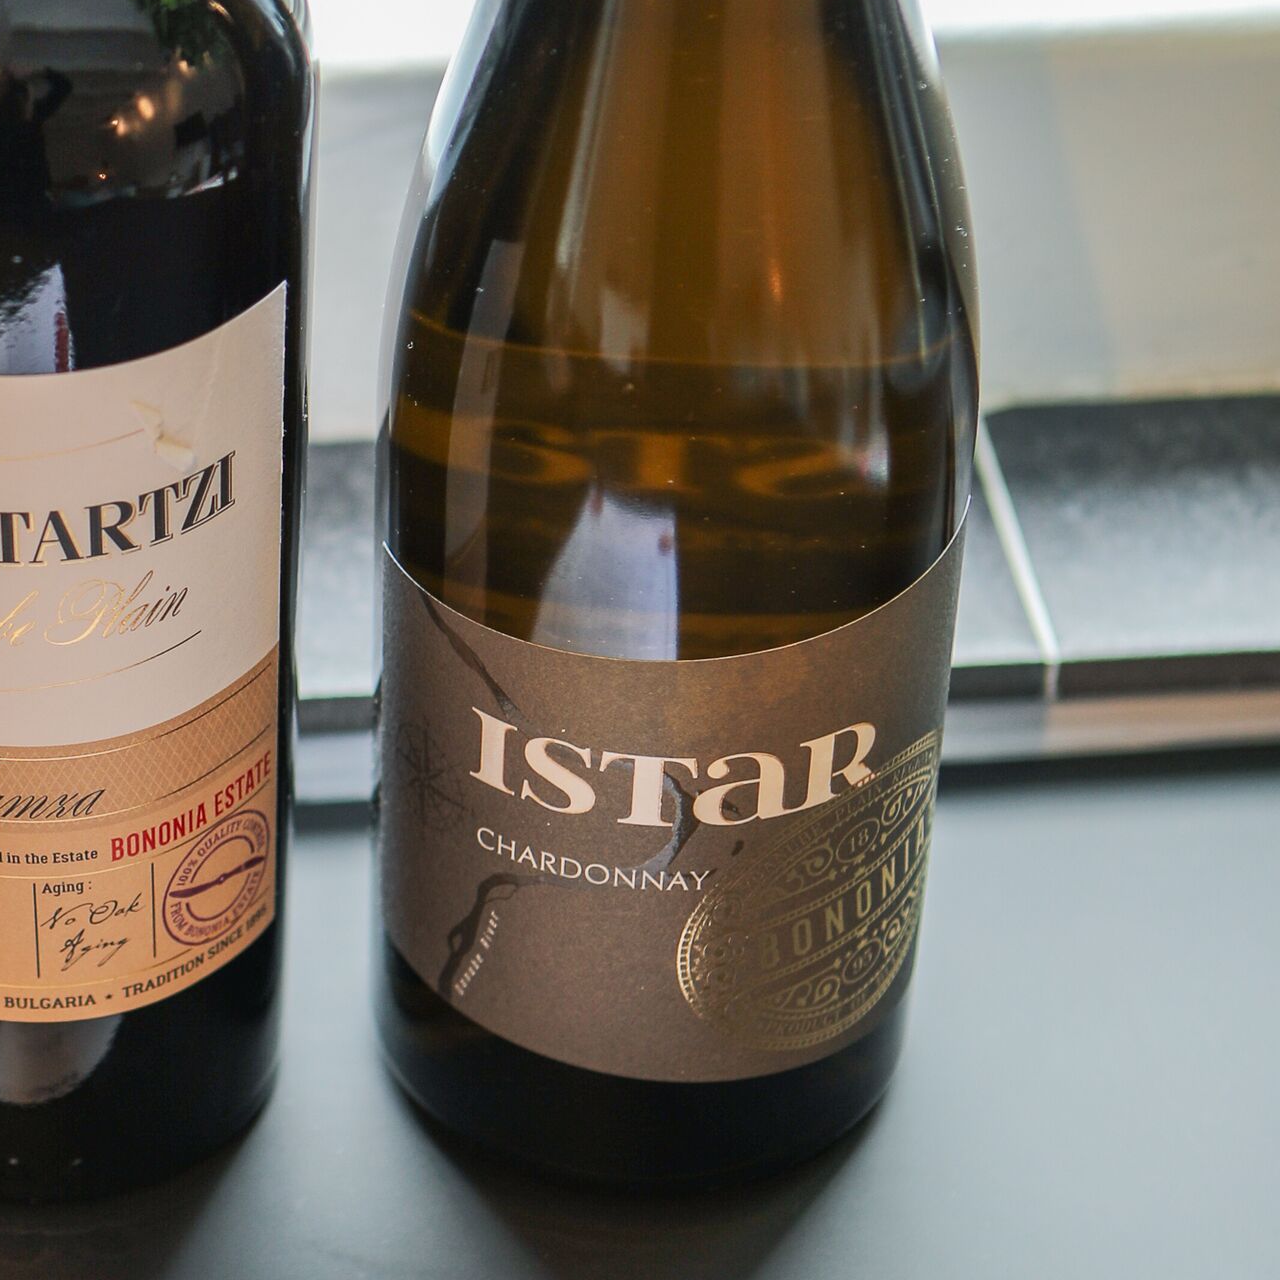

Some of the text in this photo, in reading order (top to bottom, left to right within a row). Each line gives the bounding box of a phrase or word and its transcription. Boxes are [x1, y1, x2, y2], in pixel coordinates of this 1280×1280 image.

[43, 570, 189, 648] Plain
[110, 802, 208, 862] BONONIA
[214, 751, 271, 818] ESTATE
[196, 819, 242, 858] QUALITY
[847, 825, 870, 853] 18
[6, 851, 21, 864] in
[24, 851, 49, 865] the
[52, 848, 99, 863] Estate
[475, 826, 711, 892] CHARDONNAY
[89, 891, 144, 926] Oak
[759, 818, 927, 966] BONONIA
[3, 993, 96, 1010] BULGARIA
[121, 953, 205, 999] TRADITION
[207, 927, 244, 959] SINCE
